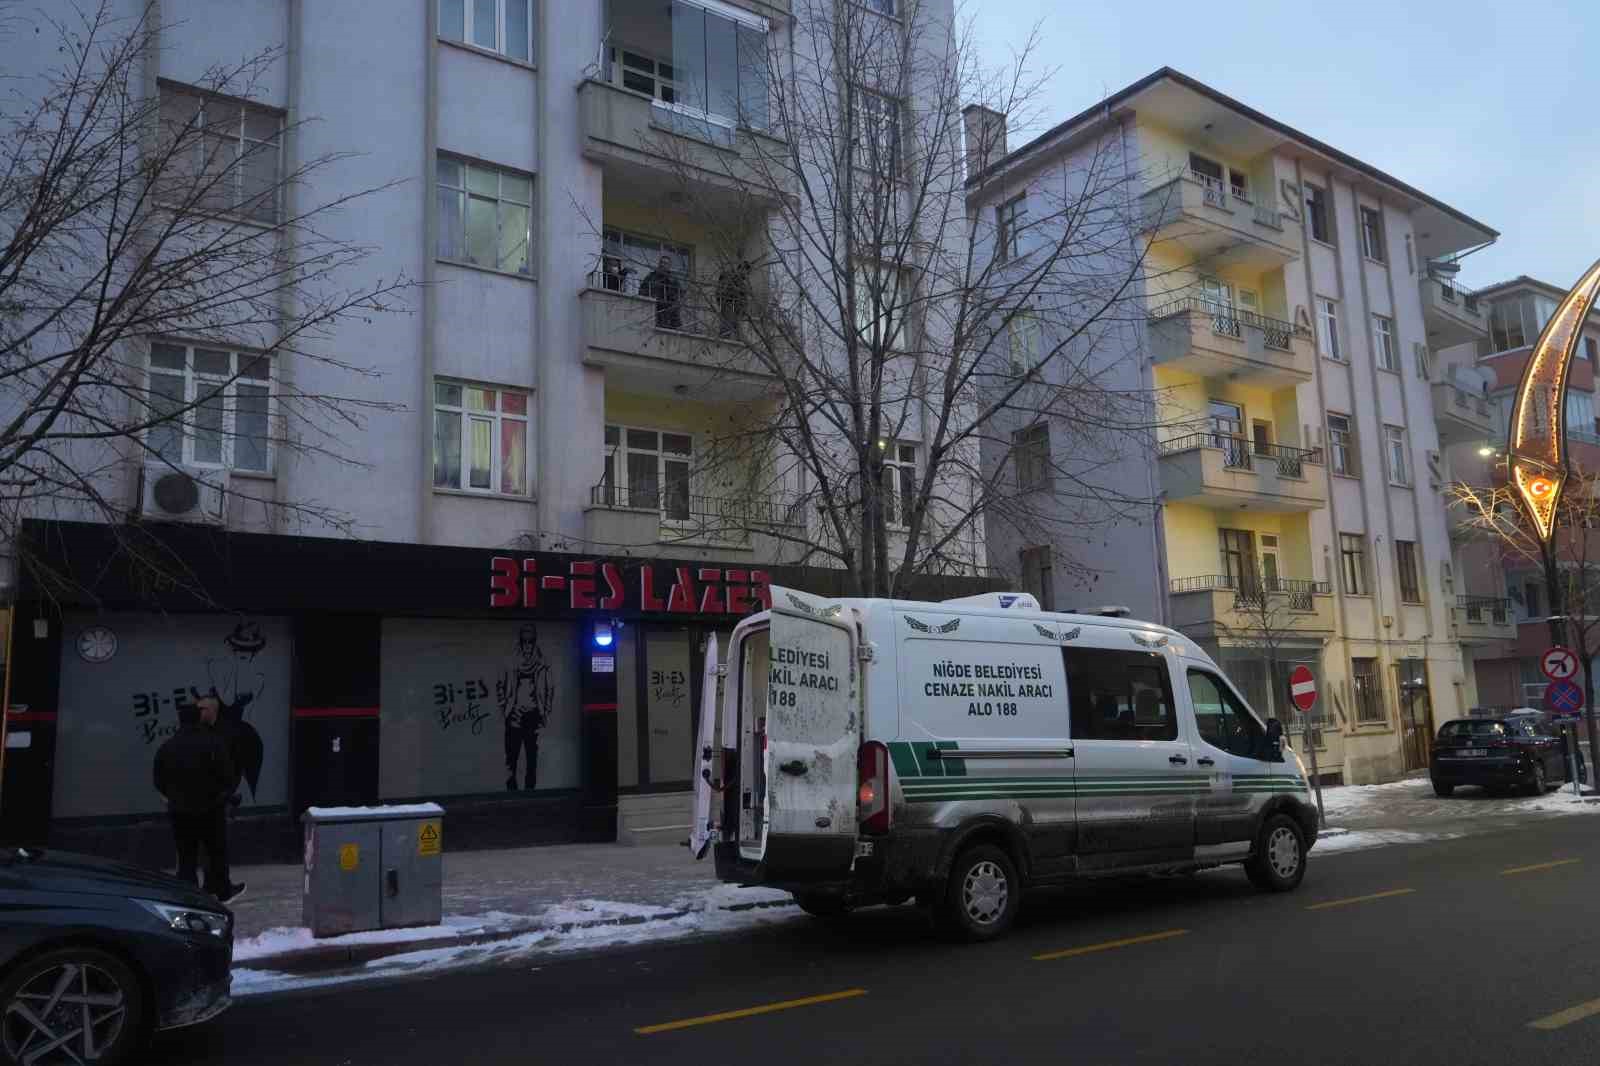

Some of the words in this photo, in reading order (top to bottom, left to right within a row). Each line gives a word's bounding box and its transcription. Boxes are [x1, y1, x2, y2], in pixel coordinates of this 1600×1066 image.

[640, 564, 772, 614] LAZER
[932, 660, 972, 678] NİĞDE
[974, 662, 1042, 679] BELEDİYESİ
[799, 672, 838, 692] ARACI
[924, 682, 975, 697] CENAZE
[977, 680, 1015, 697] NAKİL
[1018, 684, 1053, 698] ARACI
[967, 702, 992, 716] ALO
[996, 702, 1018, 716] 188
